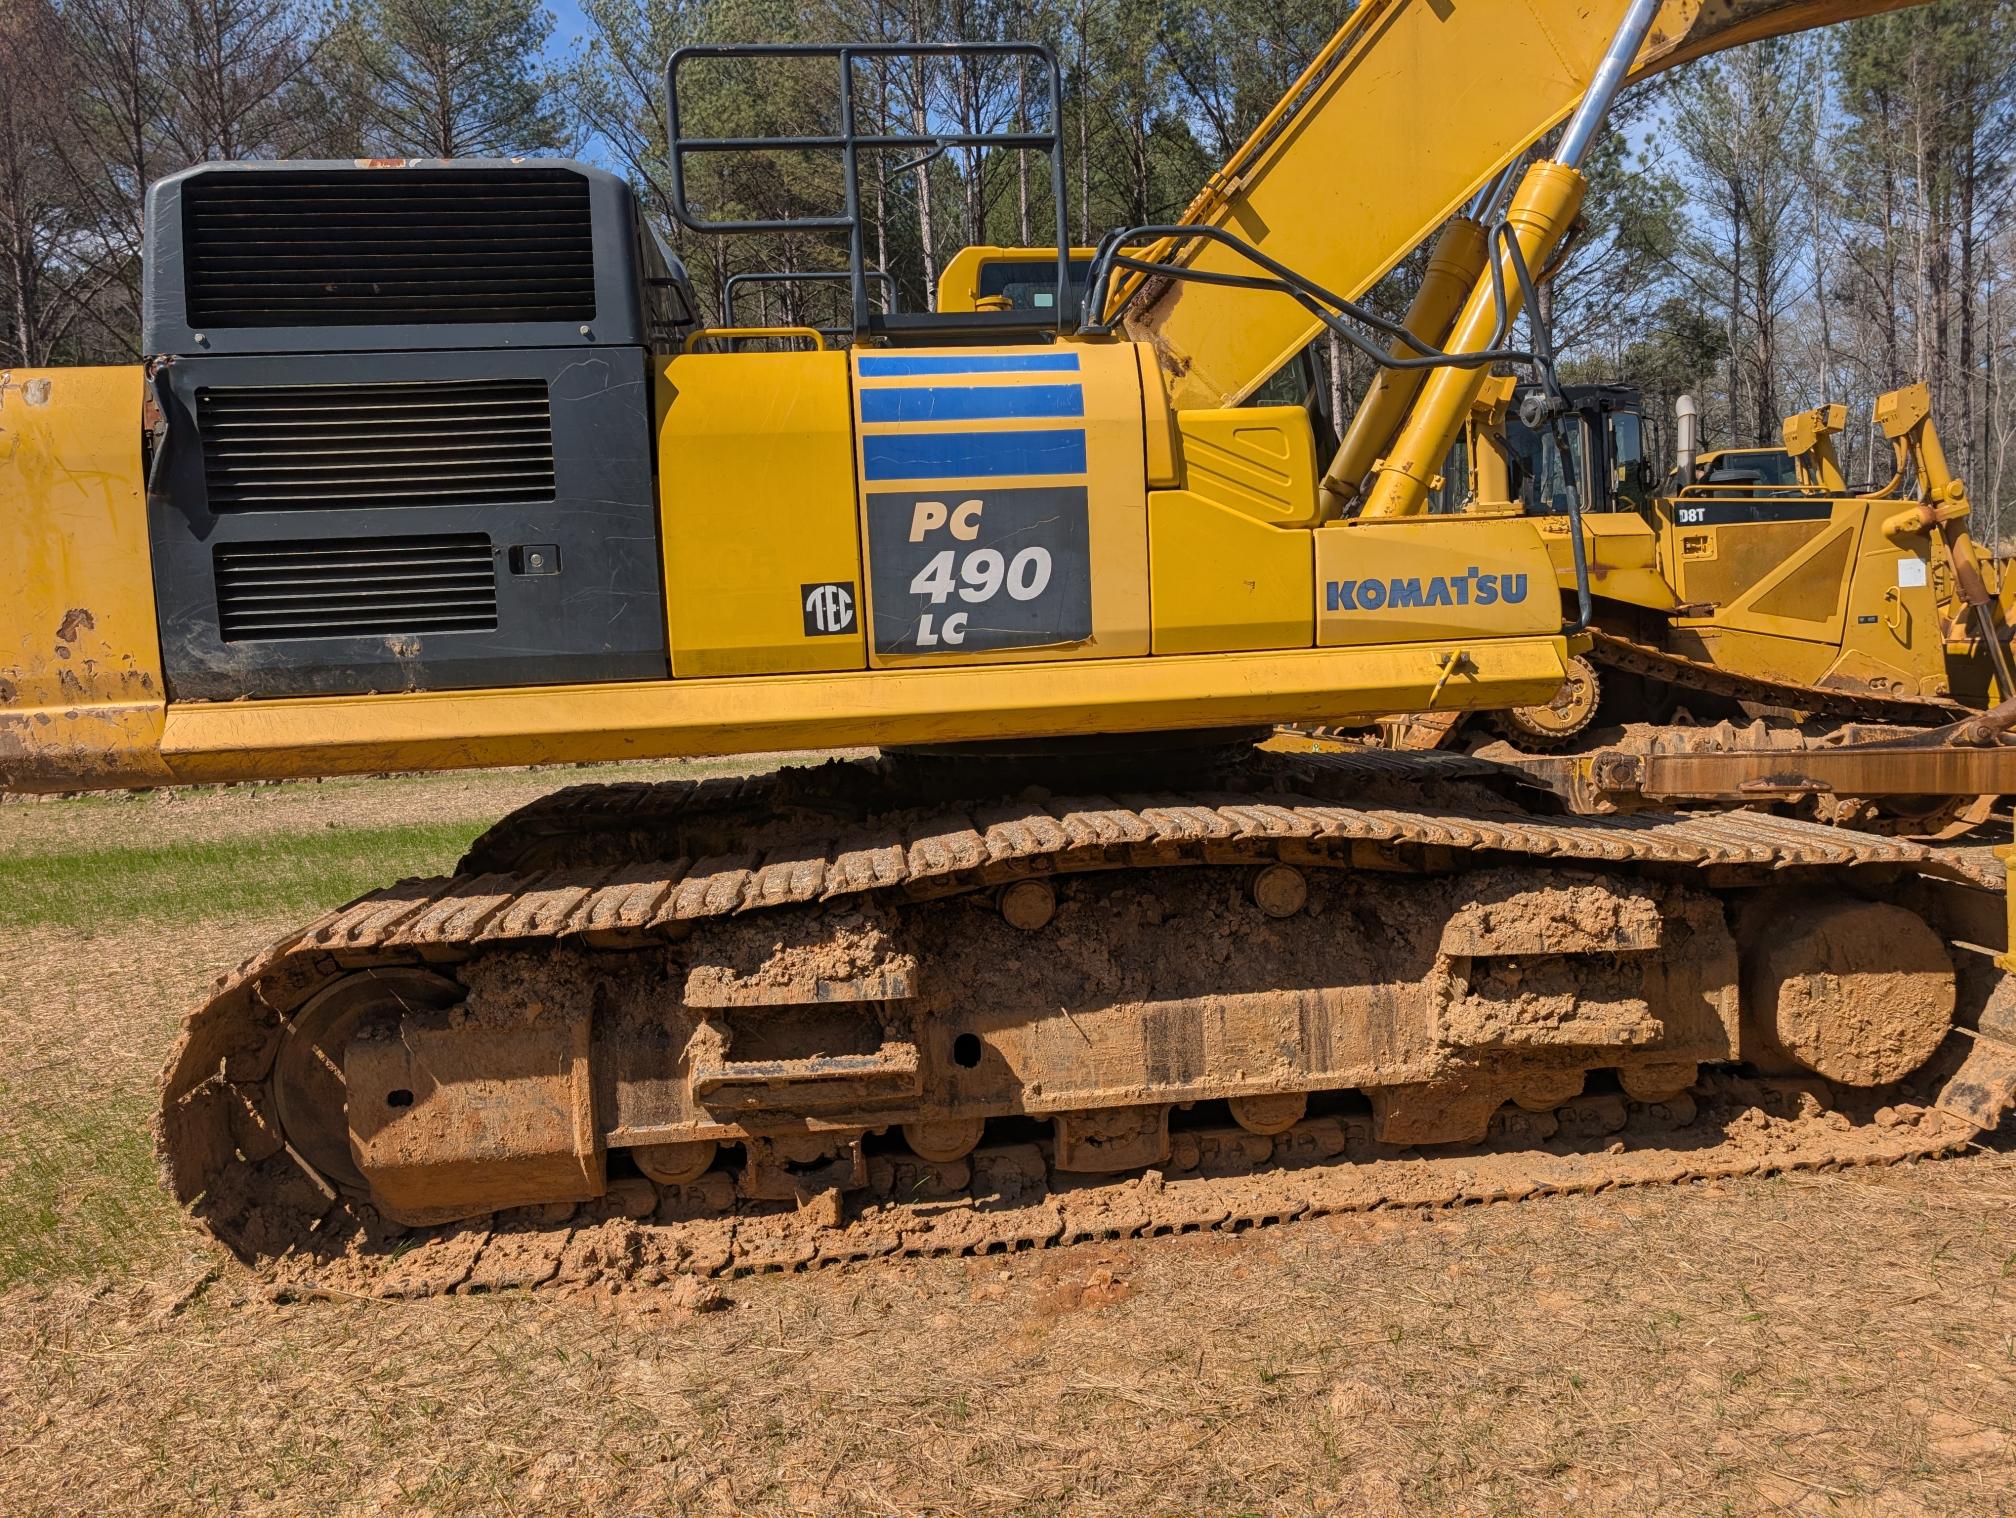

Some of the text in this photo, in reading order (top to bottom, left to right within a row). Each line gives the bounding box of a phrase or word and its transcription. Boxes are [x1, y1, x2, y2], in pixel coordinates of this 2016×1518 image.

[909, 500, 984, 542] PC
[1679, 508, 1705, 522] D8T
[910, 546, 1052, 603] 490
[1326, 566, 1528, 611] KOMATSU
[916, 613, 968, 646] LC
